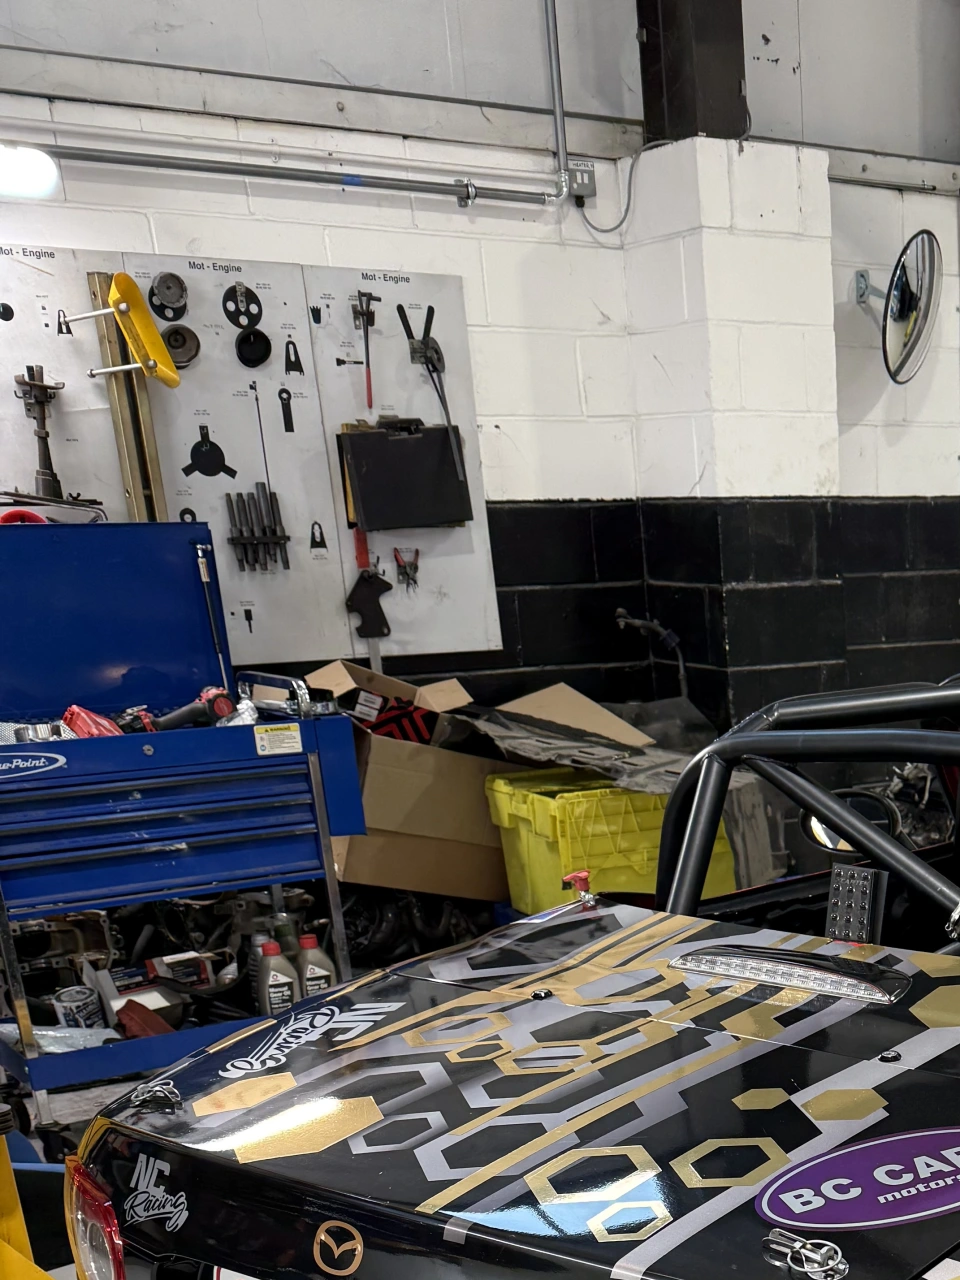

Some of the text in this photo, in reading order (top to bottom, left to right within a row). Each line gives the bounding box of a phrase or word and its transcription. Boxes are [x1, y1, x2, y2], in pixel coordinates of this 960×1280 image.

[22, 247, 56, 260] Engine
[188, 260, 205, 271] Mot
[212, 262, 242, 273] Engine
[361, 272, 377, 282] Mot
[383, 273, 410, 284] Engine
[129, 1152, 171, 1194] NC
[778, 1178, 862, 1214] BC
[123, 1187, 189, 1232] Racing
